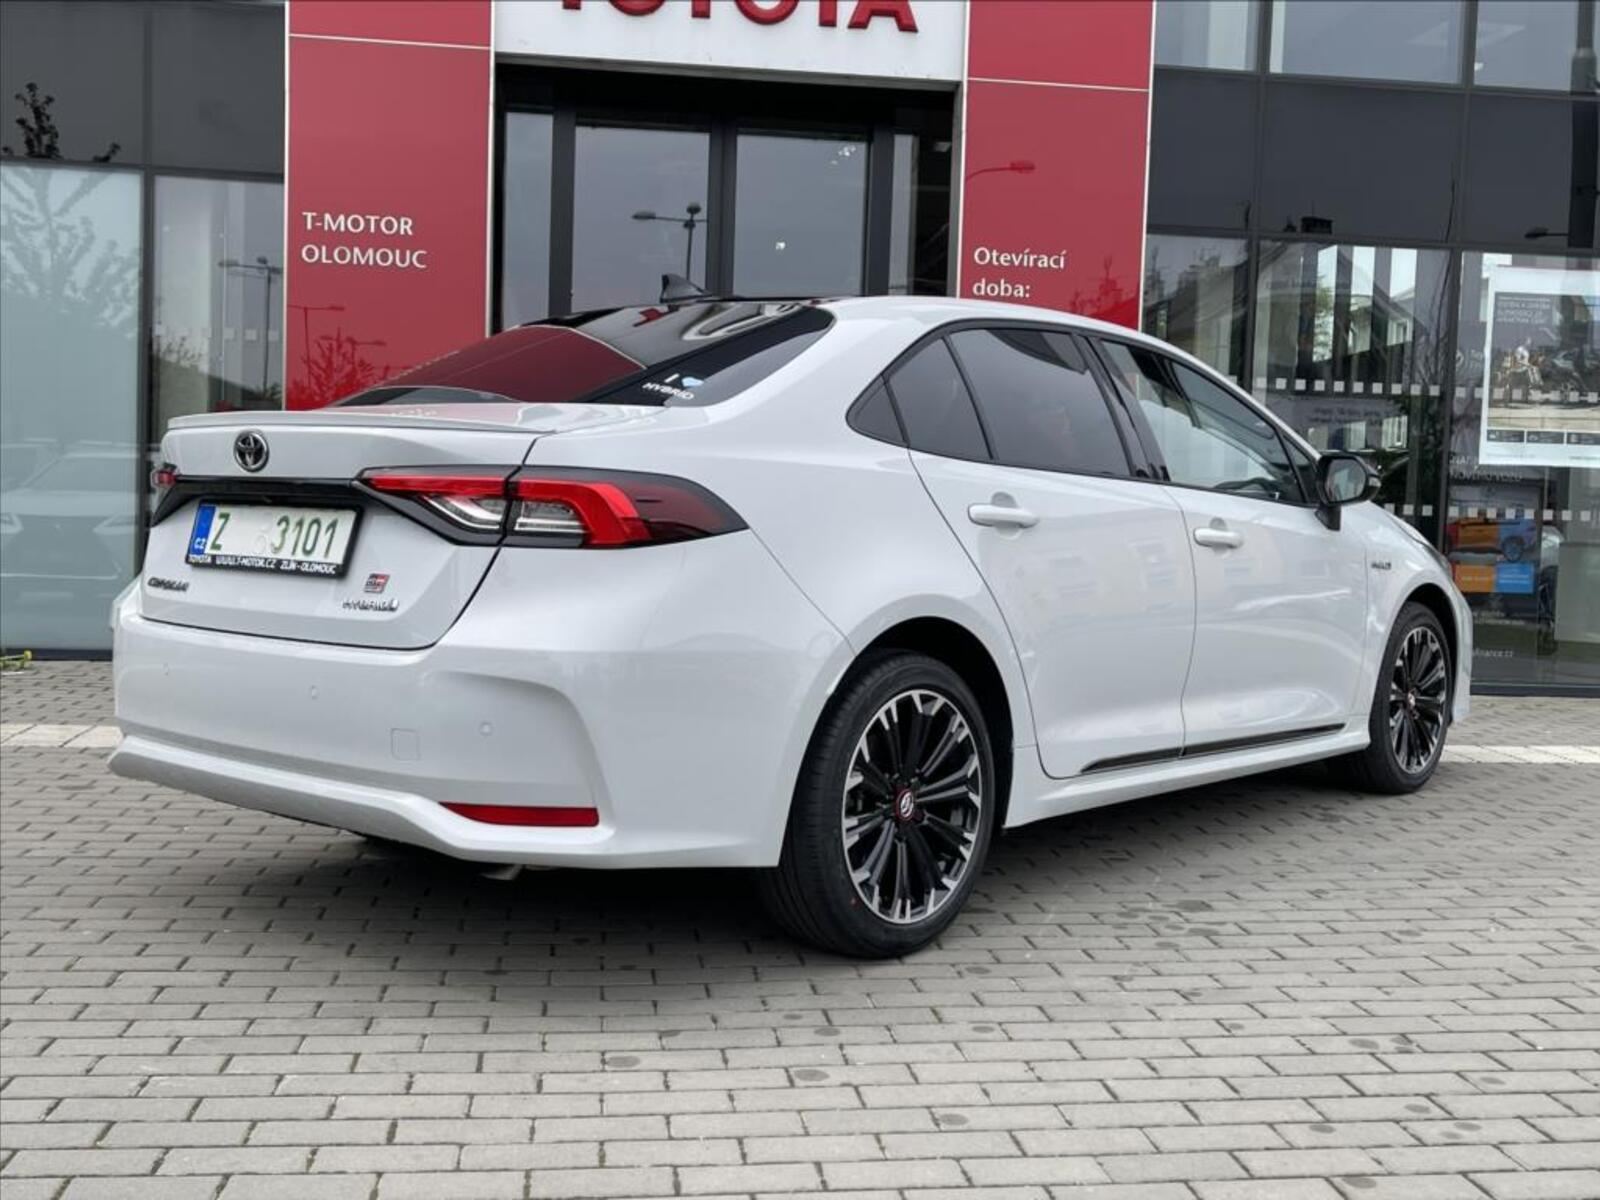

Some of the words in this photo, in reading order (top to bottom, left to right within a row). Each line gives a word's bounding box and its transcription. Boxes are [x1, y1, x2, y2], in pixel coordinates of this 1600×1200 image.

[302, 211, 413, 236] T-MOTOR
[301, 244, 427, 268] OLOMOUC
[973, 247, 1067, 269] Otevírací
[972, 277, 1031, 298] doba:
[641, 382, 694, 400] HYBRID
[193, 538, 206, 550] CZ
[210, 511, 231, 551] Z
[271, 514, 339, 559] 3101
